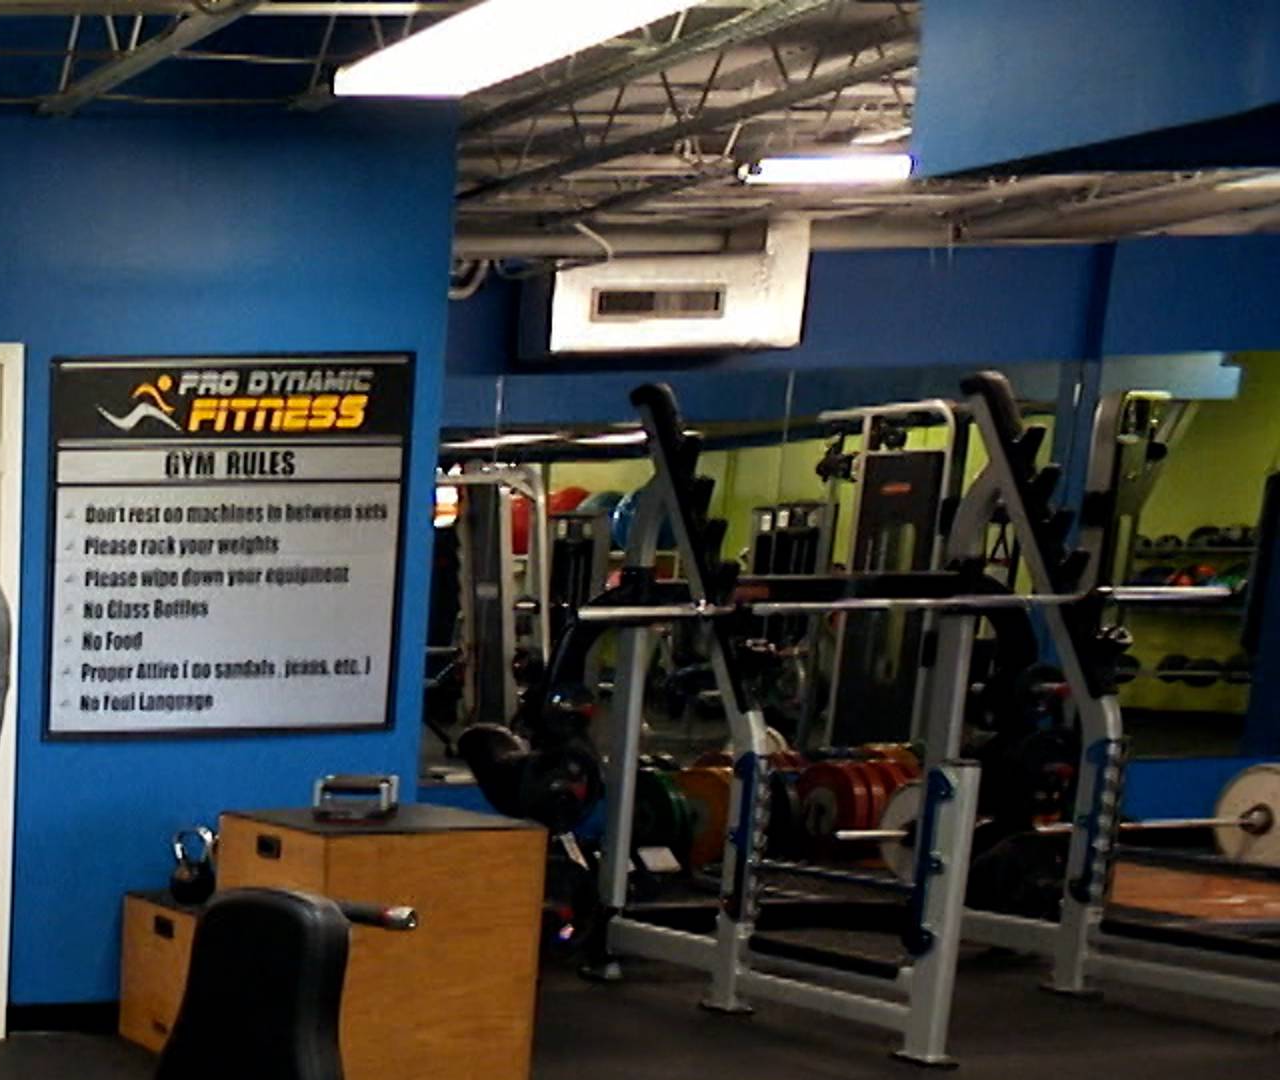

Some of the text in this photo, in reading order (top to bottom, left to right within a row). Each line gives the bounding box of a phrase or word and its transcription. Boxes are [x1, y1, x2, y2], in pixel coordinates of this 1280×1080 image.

[179, 370, 373, 395] PRO DYNAMIC
[188, 395, 368, 432] FITNESS
[165, 450, 295, 476] GYM RULES
[128, 504, 160, 522] rest
[163, 506, 183, 522] on
[186, 503, 264, 522] machines
[267, 503, 282, 521] in
[285, 503, 352, 521] between
[355, 503, 387, 520] sets
[84, 535, 279, 557] Please rack your weights
[85, 565, 349, 588] Please wipe down your equipment
[83, 599, 208, 619] No Glass Bottles
[82, 631, 142, 650] No Food
[81, 663, 133, 682] Proper
[136, 661, 178, 679] Attire
[80, 692, 214, 712] No Foul Language
